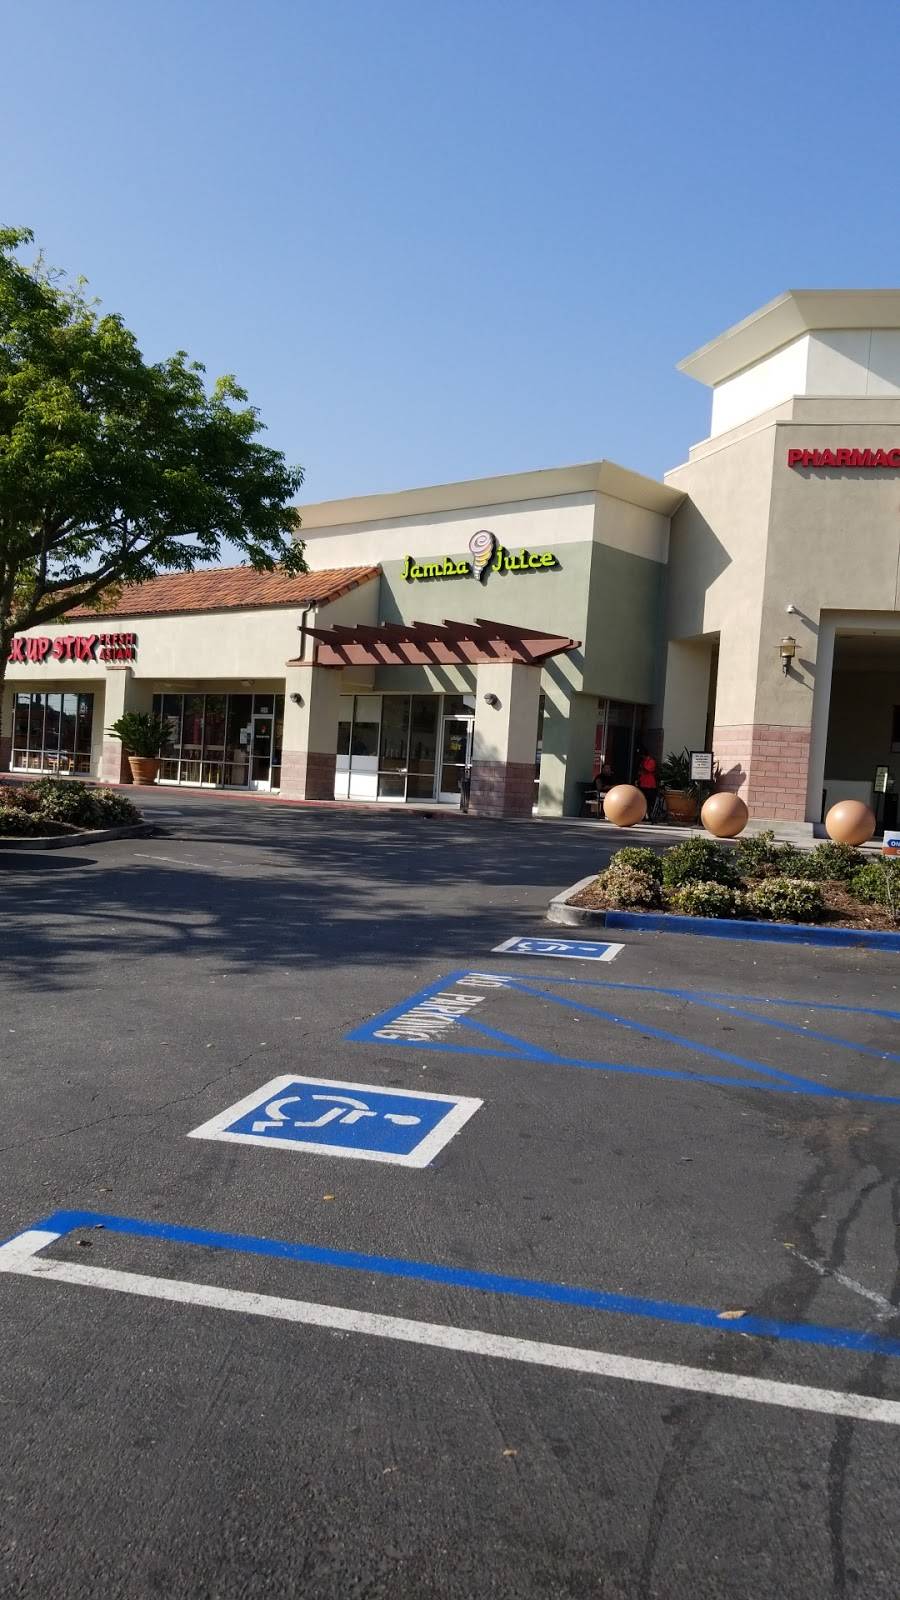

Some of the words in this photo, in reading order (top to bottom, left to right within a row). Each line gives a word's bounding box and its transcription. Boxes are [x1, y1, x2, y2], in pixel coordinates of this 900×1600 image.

[788, 448, 900, 467] PHARMAC
[26, 637, 49, 660] UP
[52, 634, 96, 660] STIX
[99, 633, 134, 646] FRESH
[99, 647, 134, 660] ASIAN
[456, 972, 518, 989] NO
[372, 992, 487, 1042] PARKING
